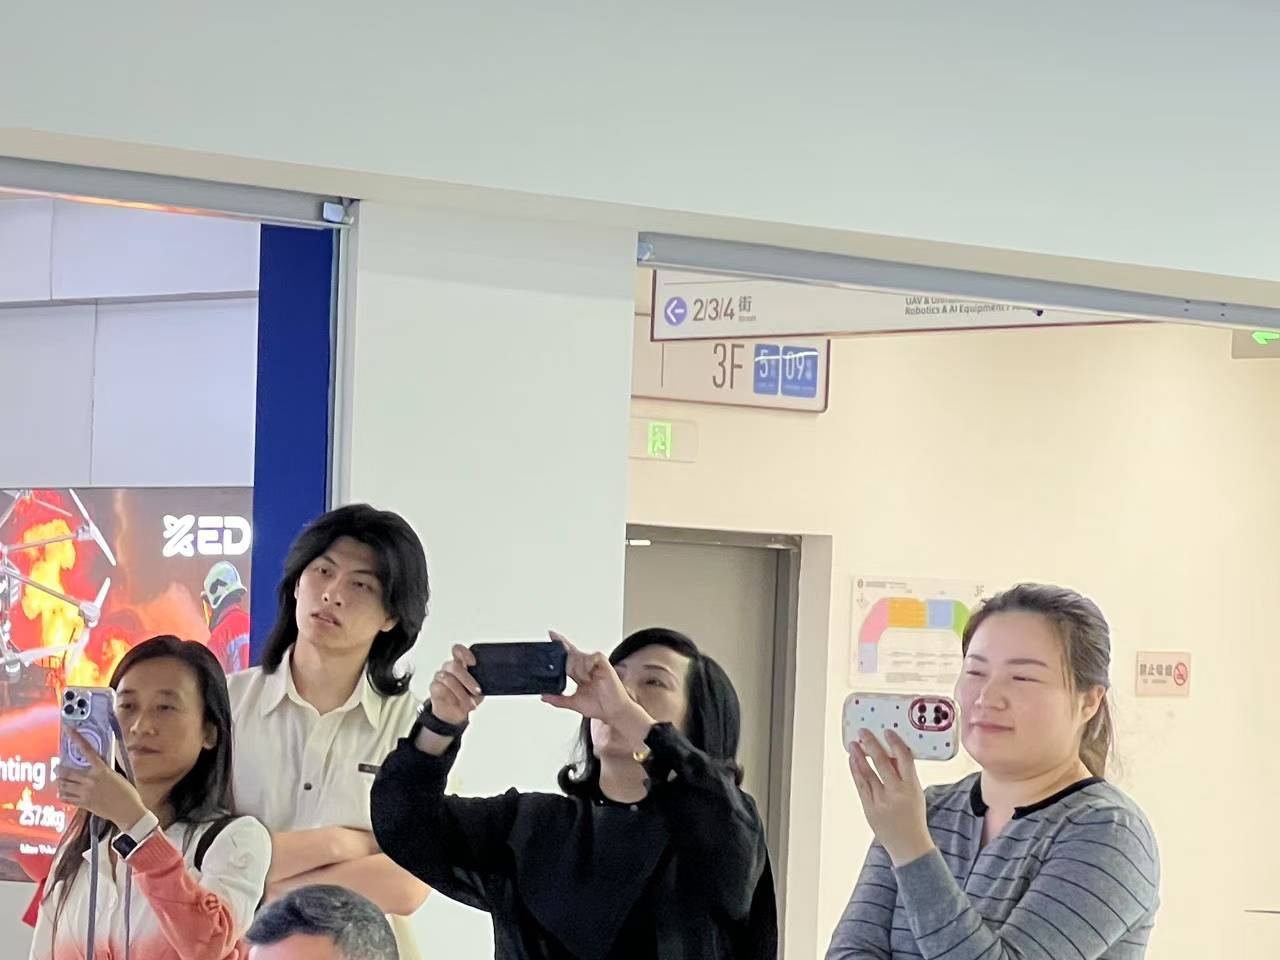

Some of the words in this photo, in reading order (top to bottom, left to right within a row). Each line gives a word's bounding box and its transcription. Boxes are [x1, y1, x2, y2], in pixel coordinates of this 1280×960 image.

[692, 297, 735, 322] 2/3/4
[738, 296, 752, 313] 街
[905, 305, 940, 315] Robotics
[949, 304, 957, 313] AI
[712, 343, 745, 390] 3F
